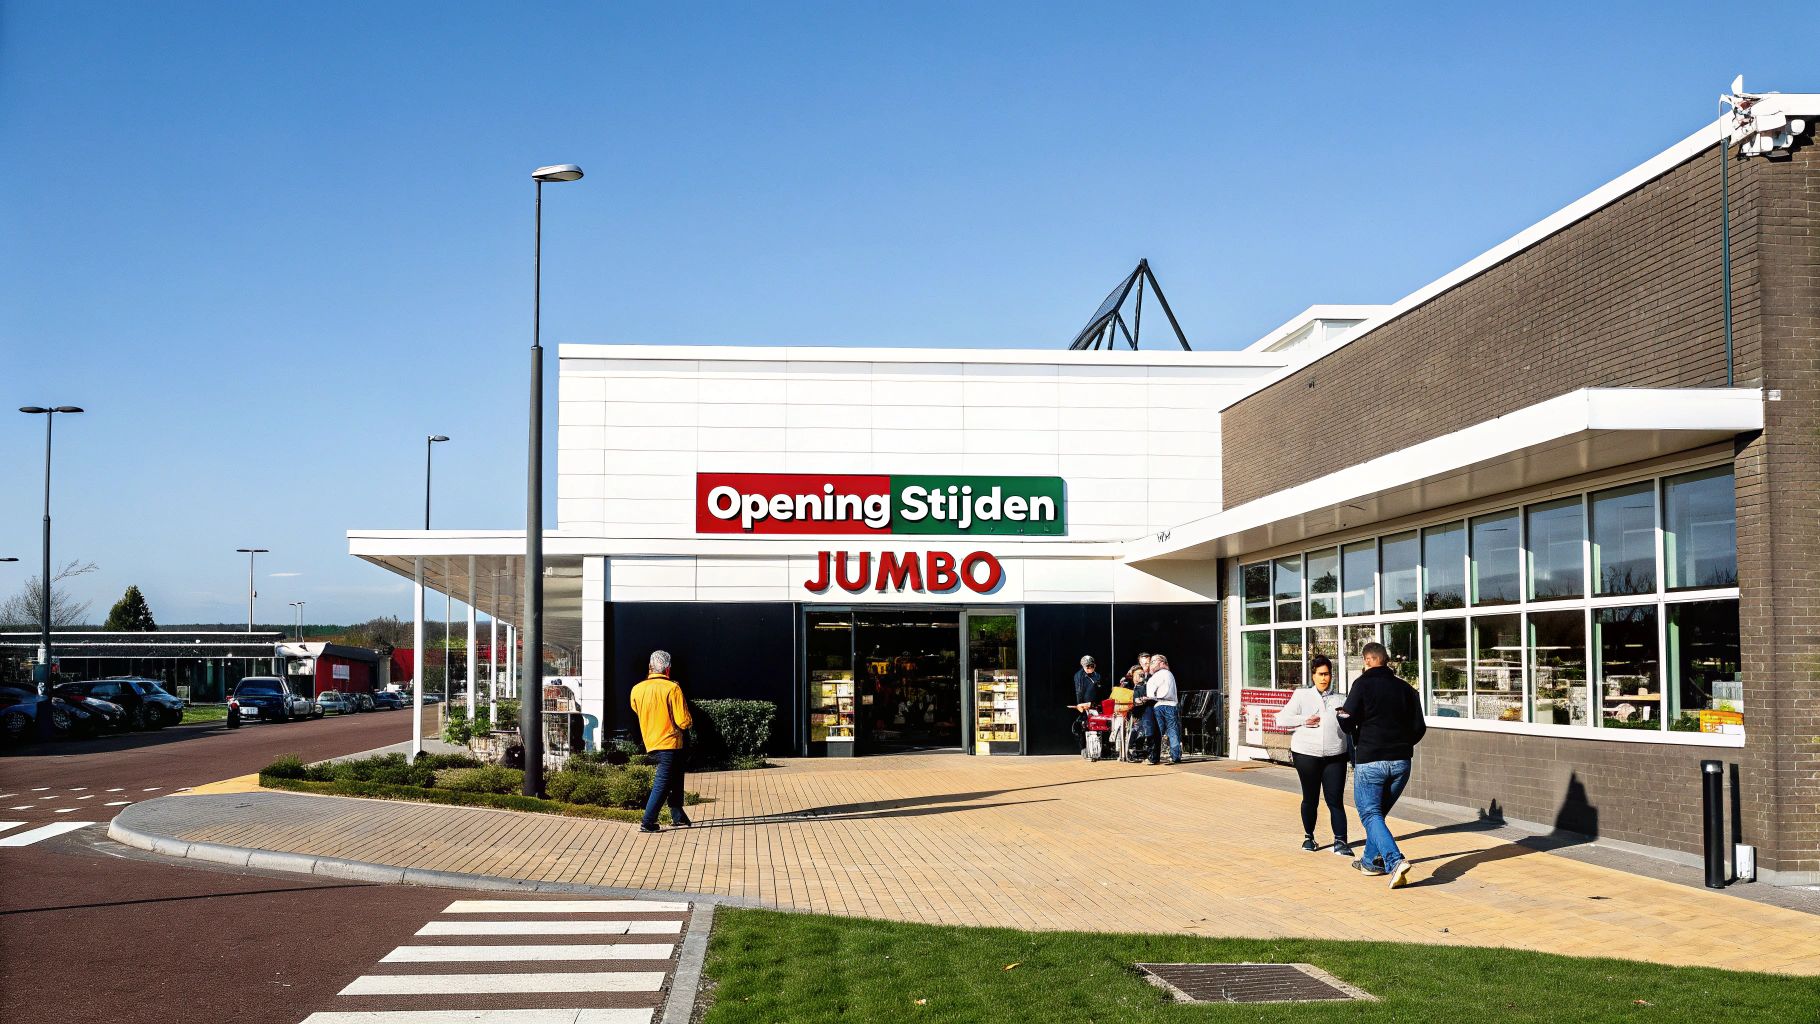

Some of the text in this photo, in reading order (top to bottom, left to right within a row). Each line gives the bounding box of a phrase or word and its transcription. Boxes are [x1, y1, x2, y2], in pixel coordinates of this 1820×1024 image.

[707, 483, 1055, 529] Opening Stijden
[803, 550, 1002, 593] JUMBO
